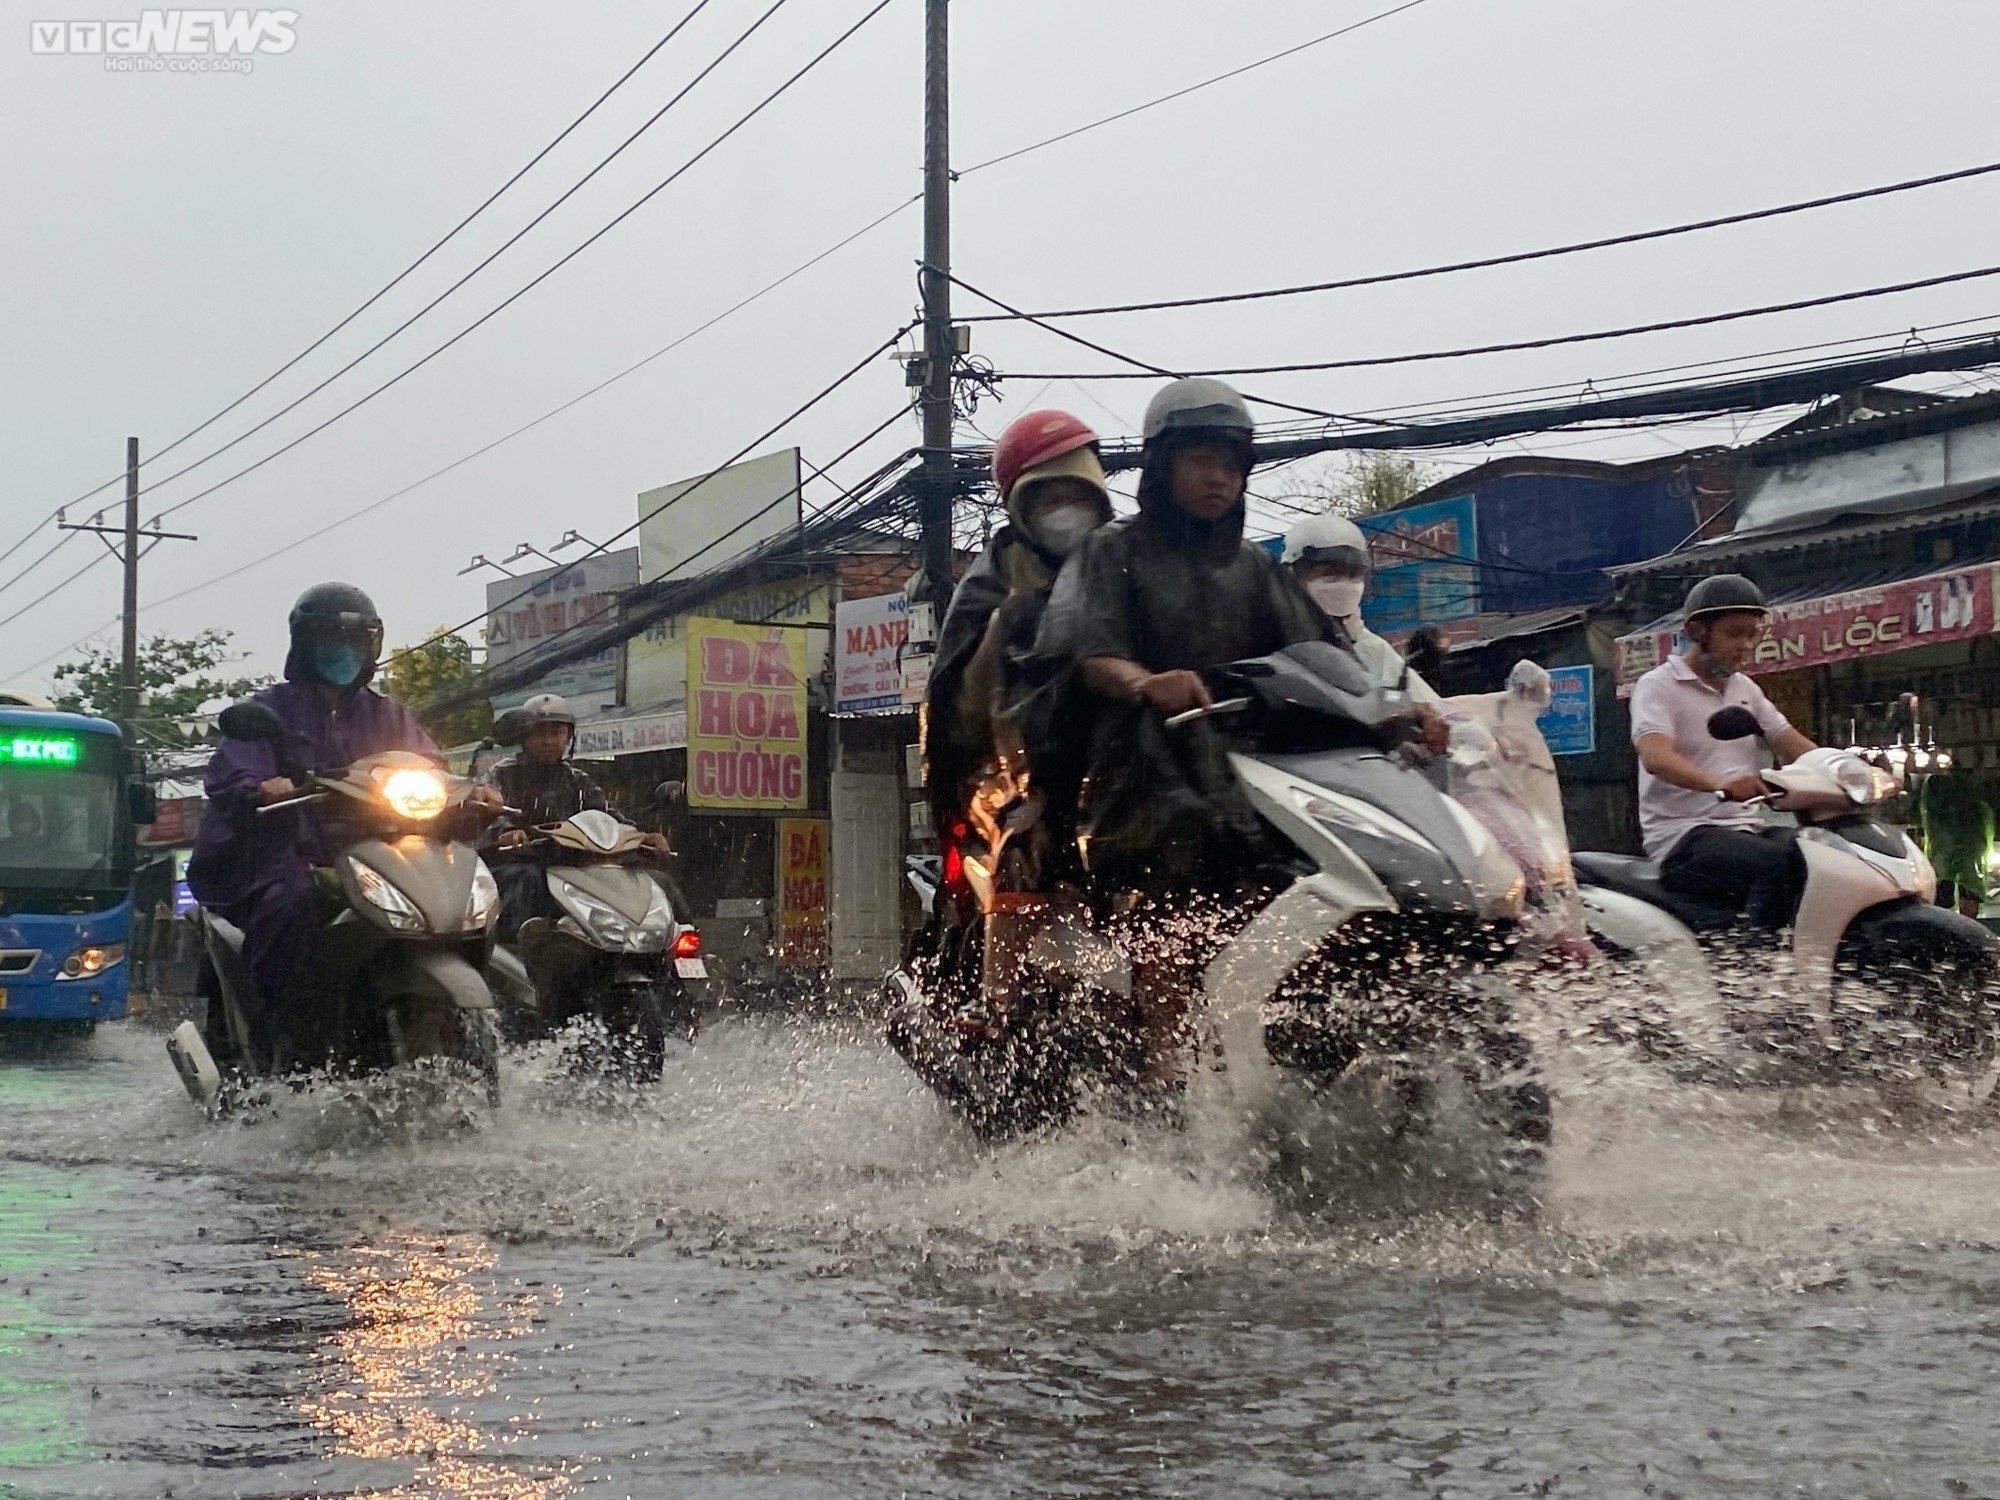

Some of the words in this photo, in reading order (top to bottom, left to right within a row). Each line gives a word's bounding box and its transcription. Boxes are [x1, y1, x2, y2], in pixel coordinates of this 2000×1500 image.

[702, 626, 798, 688] ĐÁ
[1755, 625, 1806, 665] ẤN
[1821, 612, 1901, 654] LỘC
[697, 689, 800, 740] HOA
[695, 740, 802, 800] CƯƠNG
